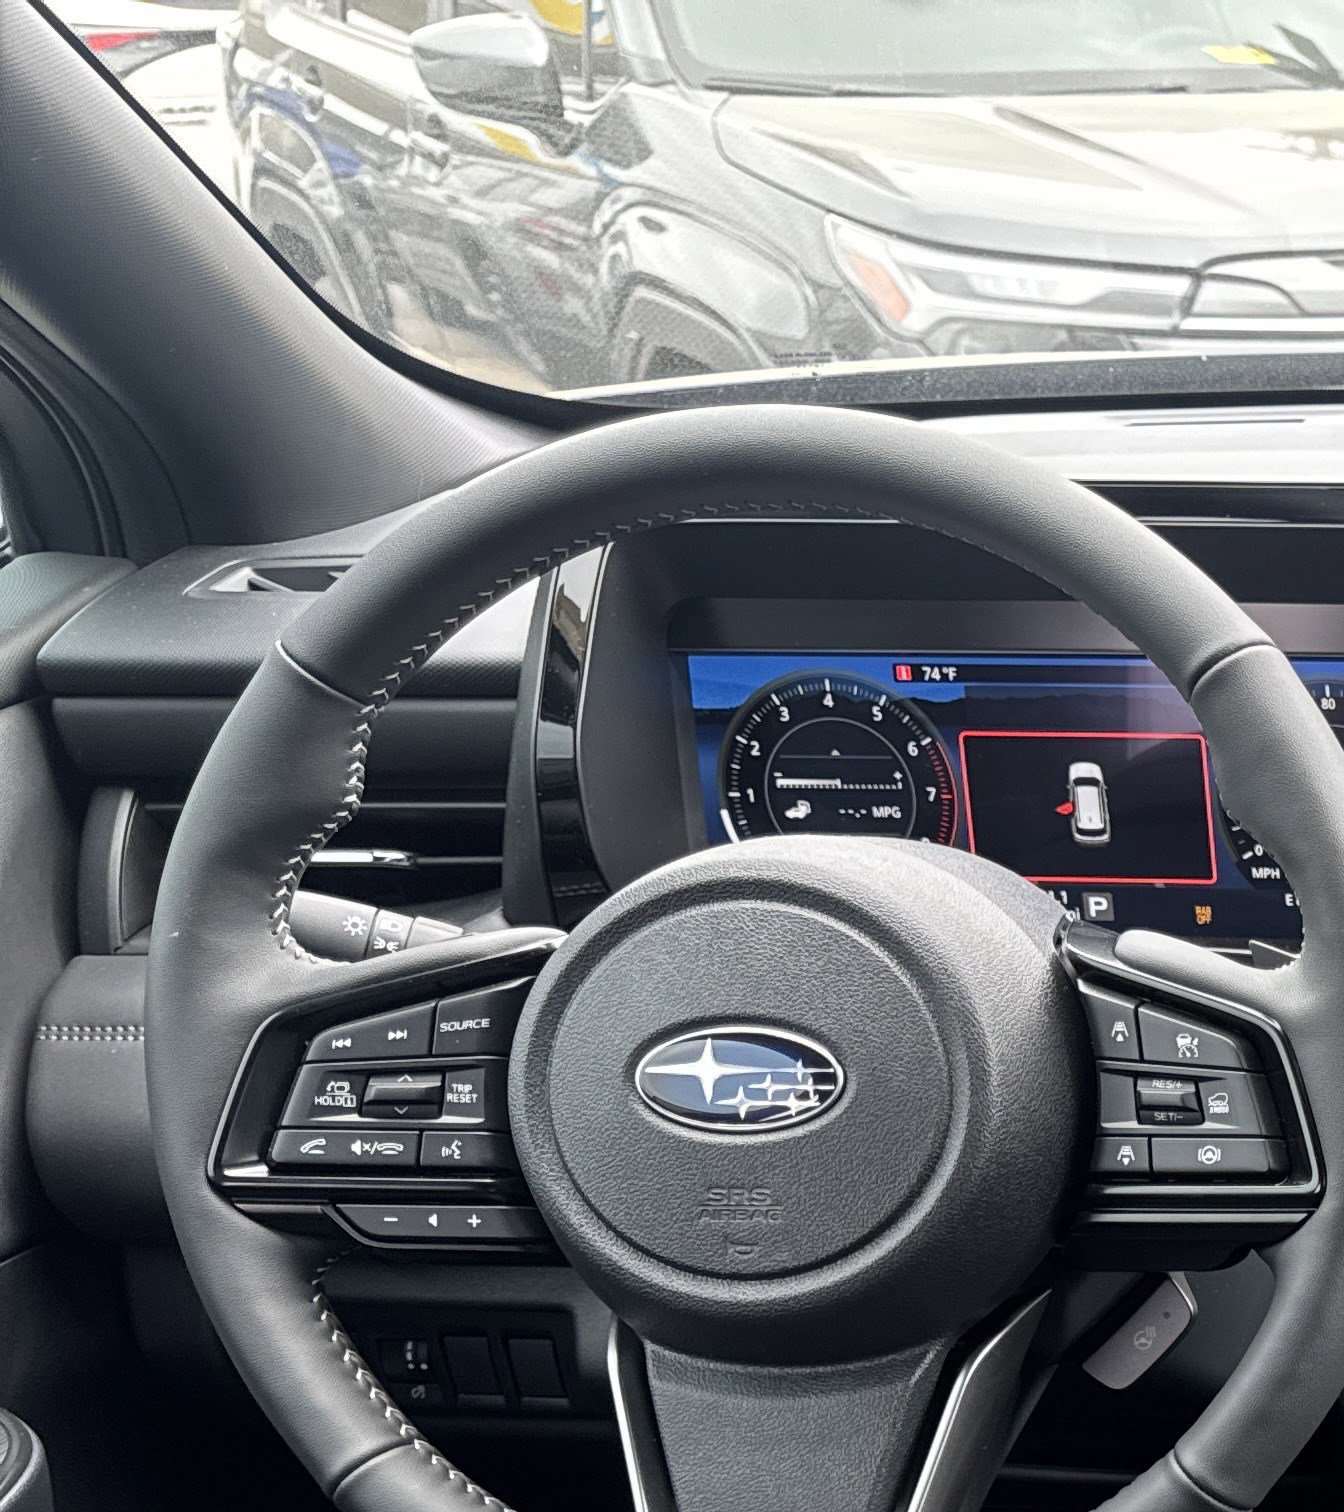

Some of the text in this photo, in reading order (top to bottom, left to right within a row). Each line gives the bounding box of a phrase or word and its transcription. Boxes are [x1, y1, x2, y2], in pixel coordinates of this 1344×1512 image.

[921, 666, 957, 682] 74°F
[823, 692, 834, 708] 4
[1321, 698, 1336, 710] 80
[779, 706, 790, 722] 3
[872, 706, 883, 721] 5
[750, 741, 761, 756] 2
[907, 741, 918, 757] 6
[746, 788, 755, 803] 1
[926, 787, 936, 802] 7
[871, 806, 901, 819] MPG
[1254, 844, 1264, 856] 0
[1252, 867, 1280, 880] MPH
[1089, 896, 1108, 917] P
[439, 1018, 491, 1032] SOURCE
[451, 1083, 473, 1094] TRIP
[447, 1092, 478, 1104] RESET
[707, 1187, 774, 1206] SRS
